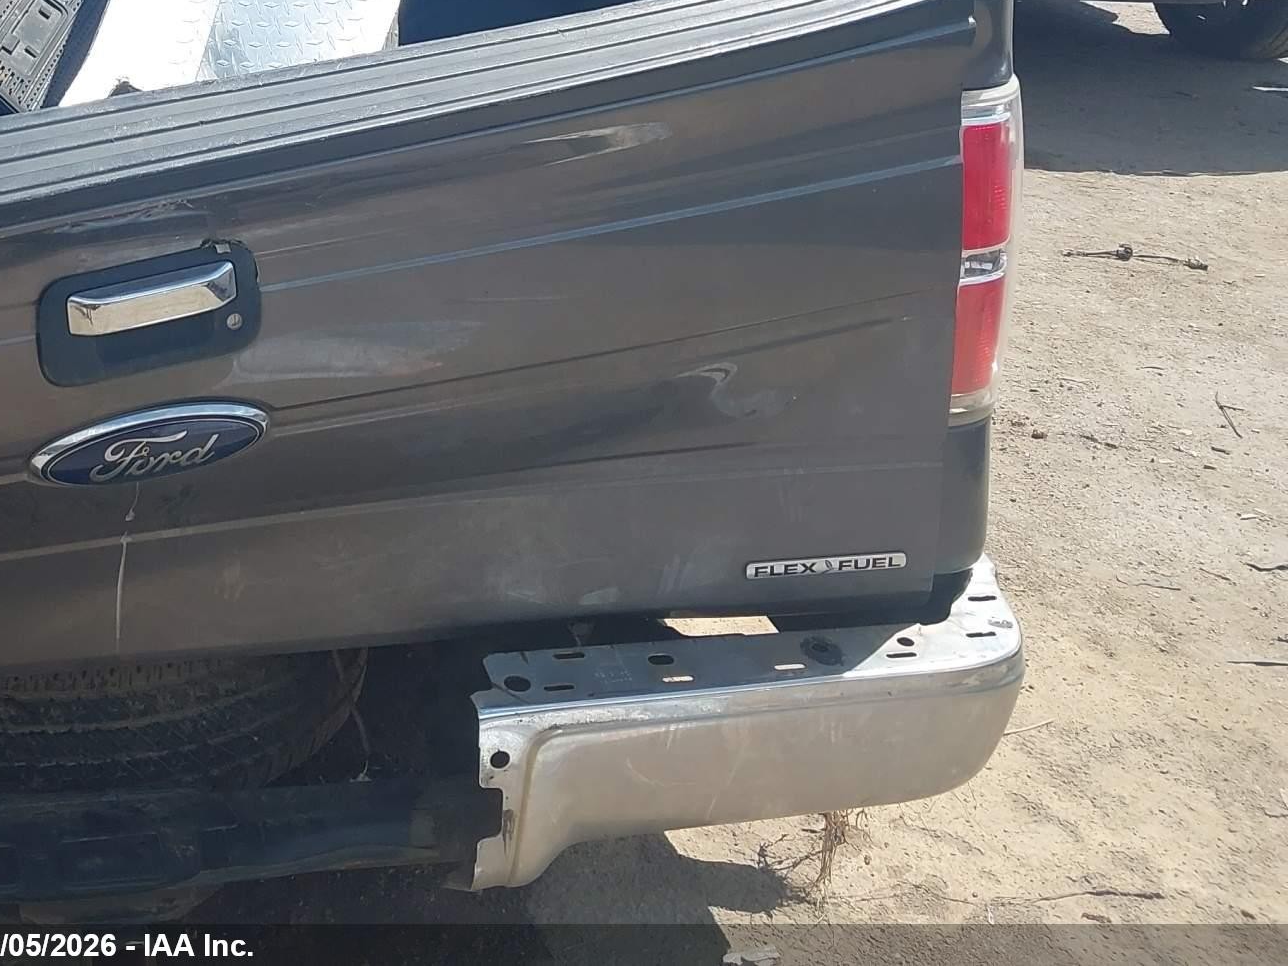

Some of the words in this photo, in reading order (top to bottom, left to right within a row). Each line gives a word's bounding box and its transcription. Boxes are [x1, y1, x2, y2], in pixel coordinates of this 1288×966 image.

[89, 430, 220, 482] Ford
[754, 562, 817, 578] FLEX
[838, 556, 902, 572] FUEL
